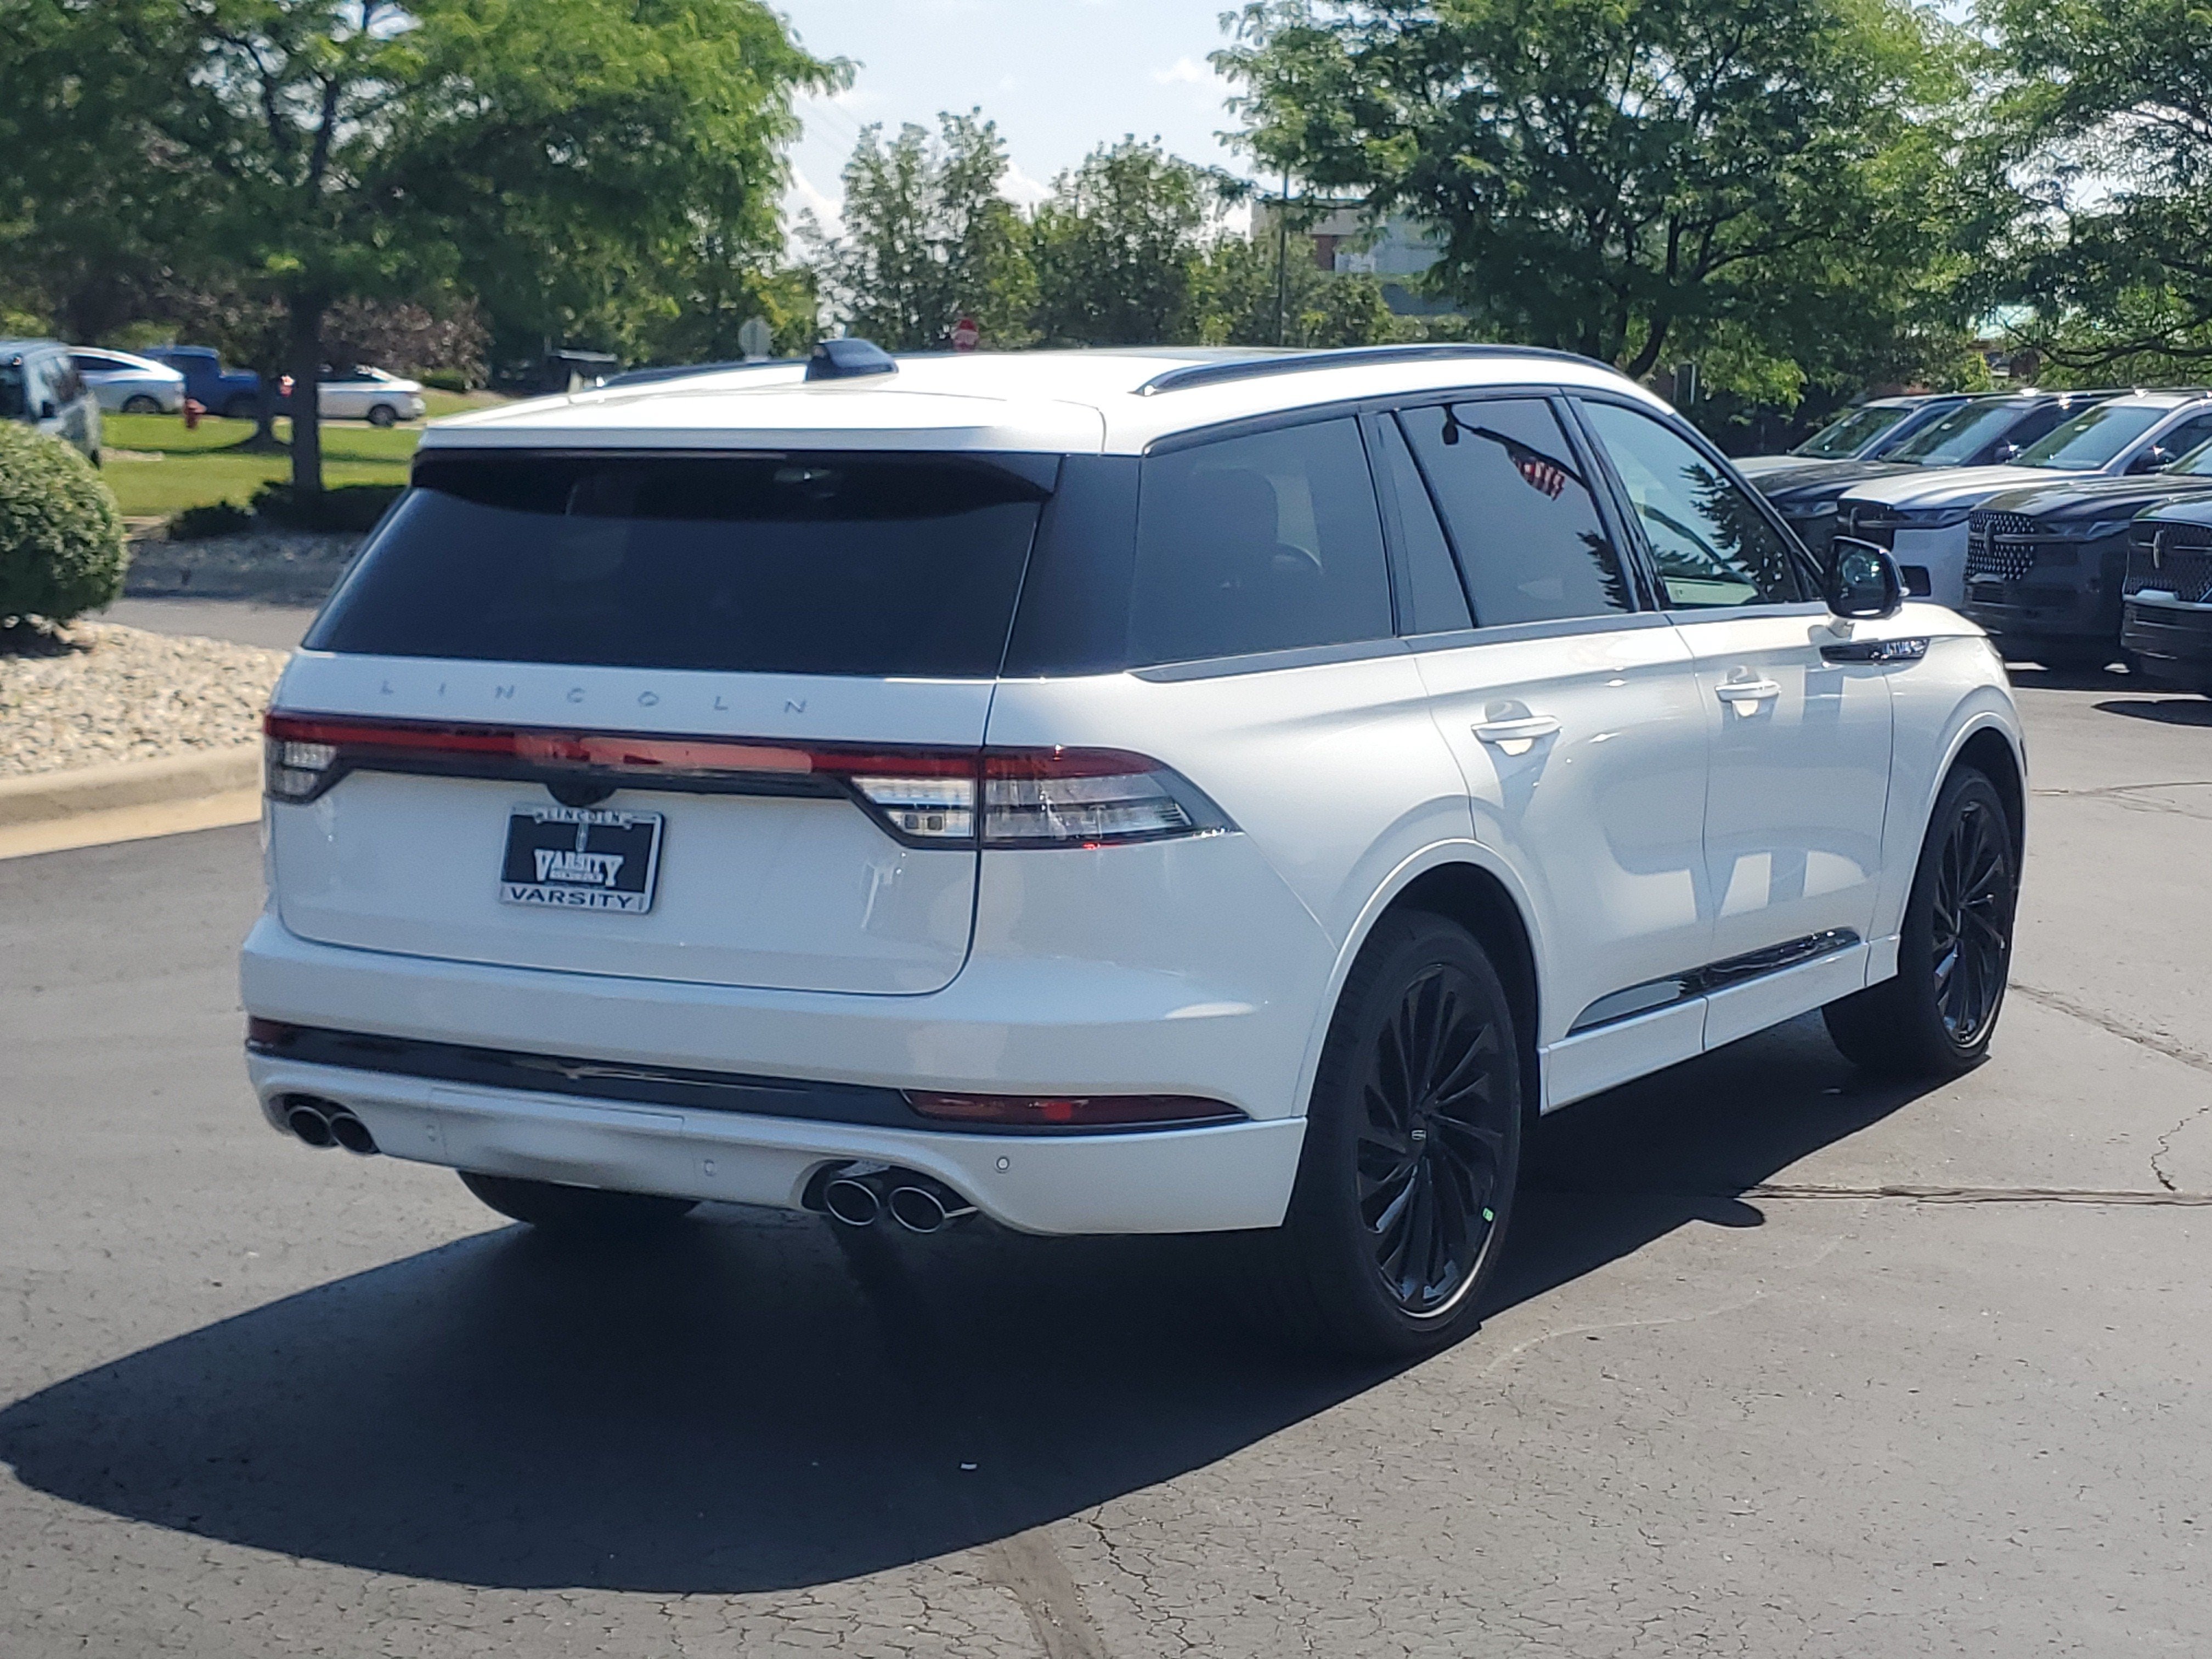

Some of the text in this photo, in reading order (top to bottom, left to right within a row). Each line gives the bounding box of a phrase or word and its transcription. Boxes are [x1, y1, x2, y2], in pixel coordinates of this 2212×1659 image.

[379, 680, 806, 714] LINCOLN
[534, 849, 624, 886] VARSITY
[510, 887, 633, 909] VARSITY
